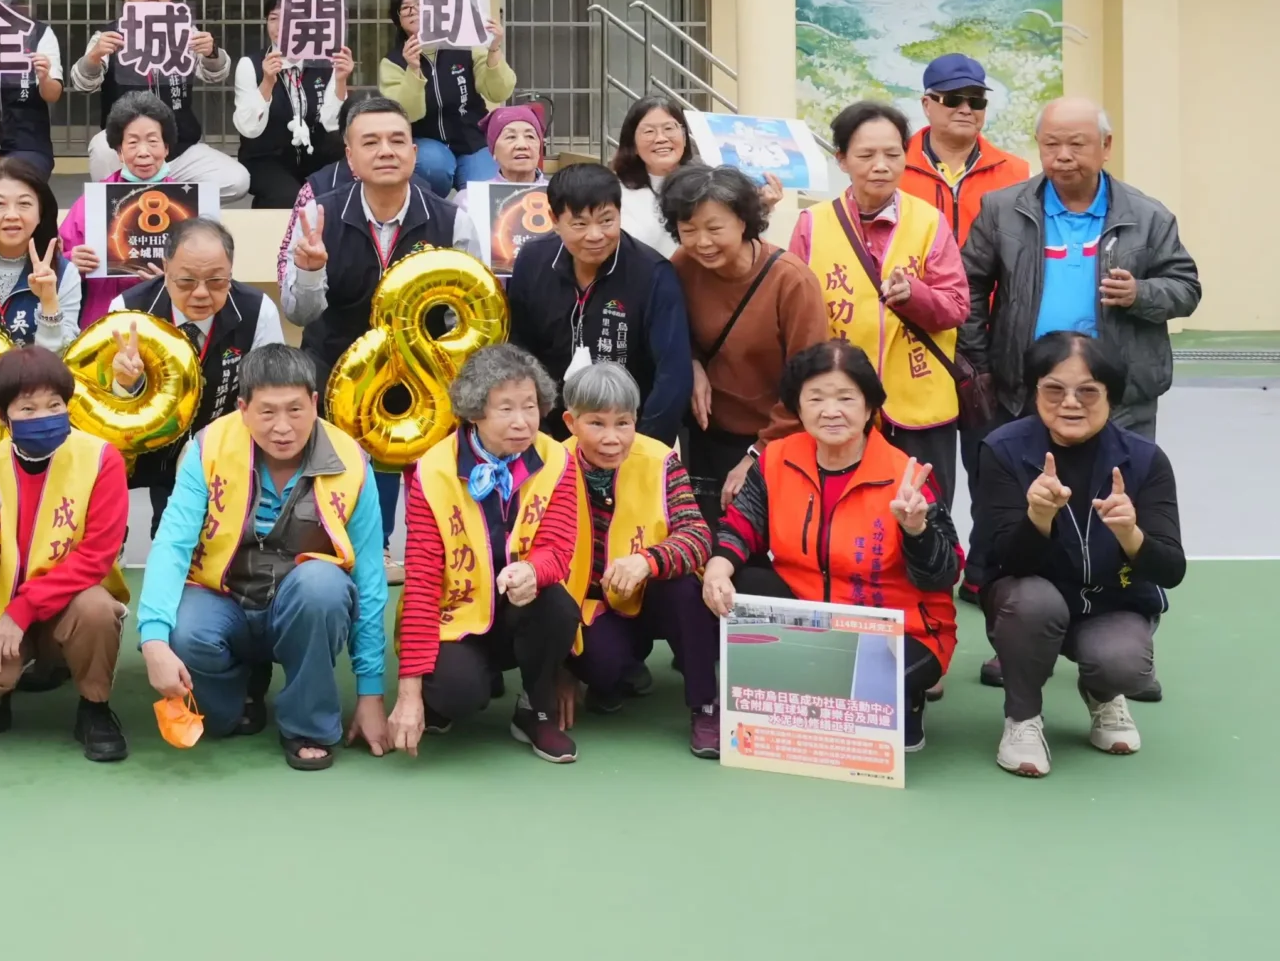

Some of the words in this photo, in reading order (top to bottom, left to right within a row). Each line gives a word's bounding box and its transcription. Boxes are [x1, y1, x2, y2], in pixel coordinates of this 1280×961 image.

[120, 2, 194, 75] 城
[138, 190, 170, 233] 8
[522, 191, 553, 233] 8
